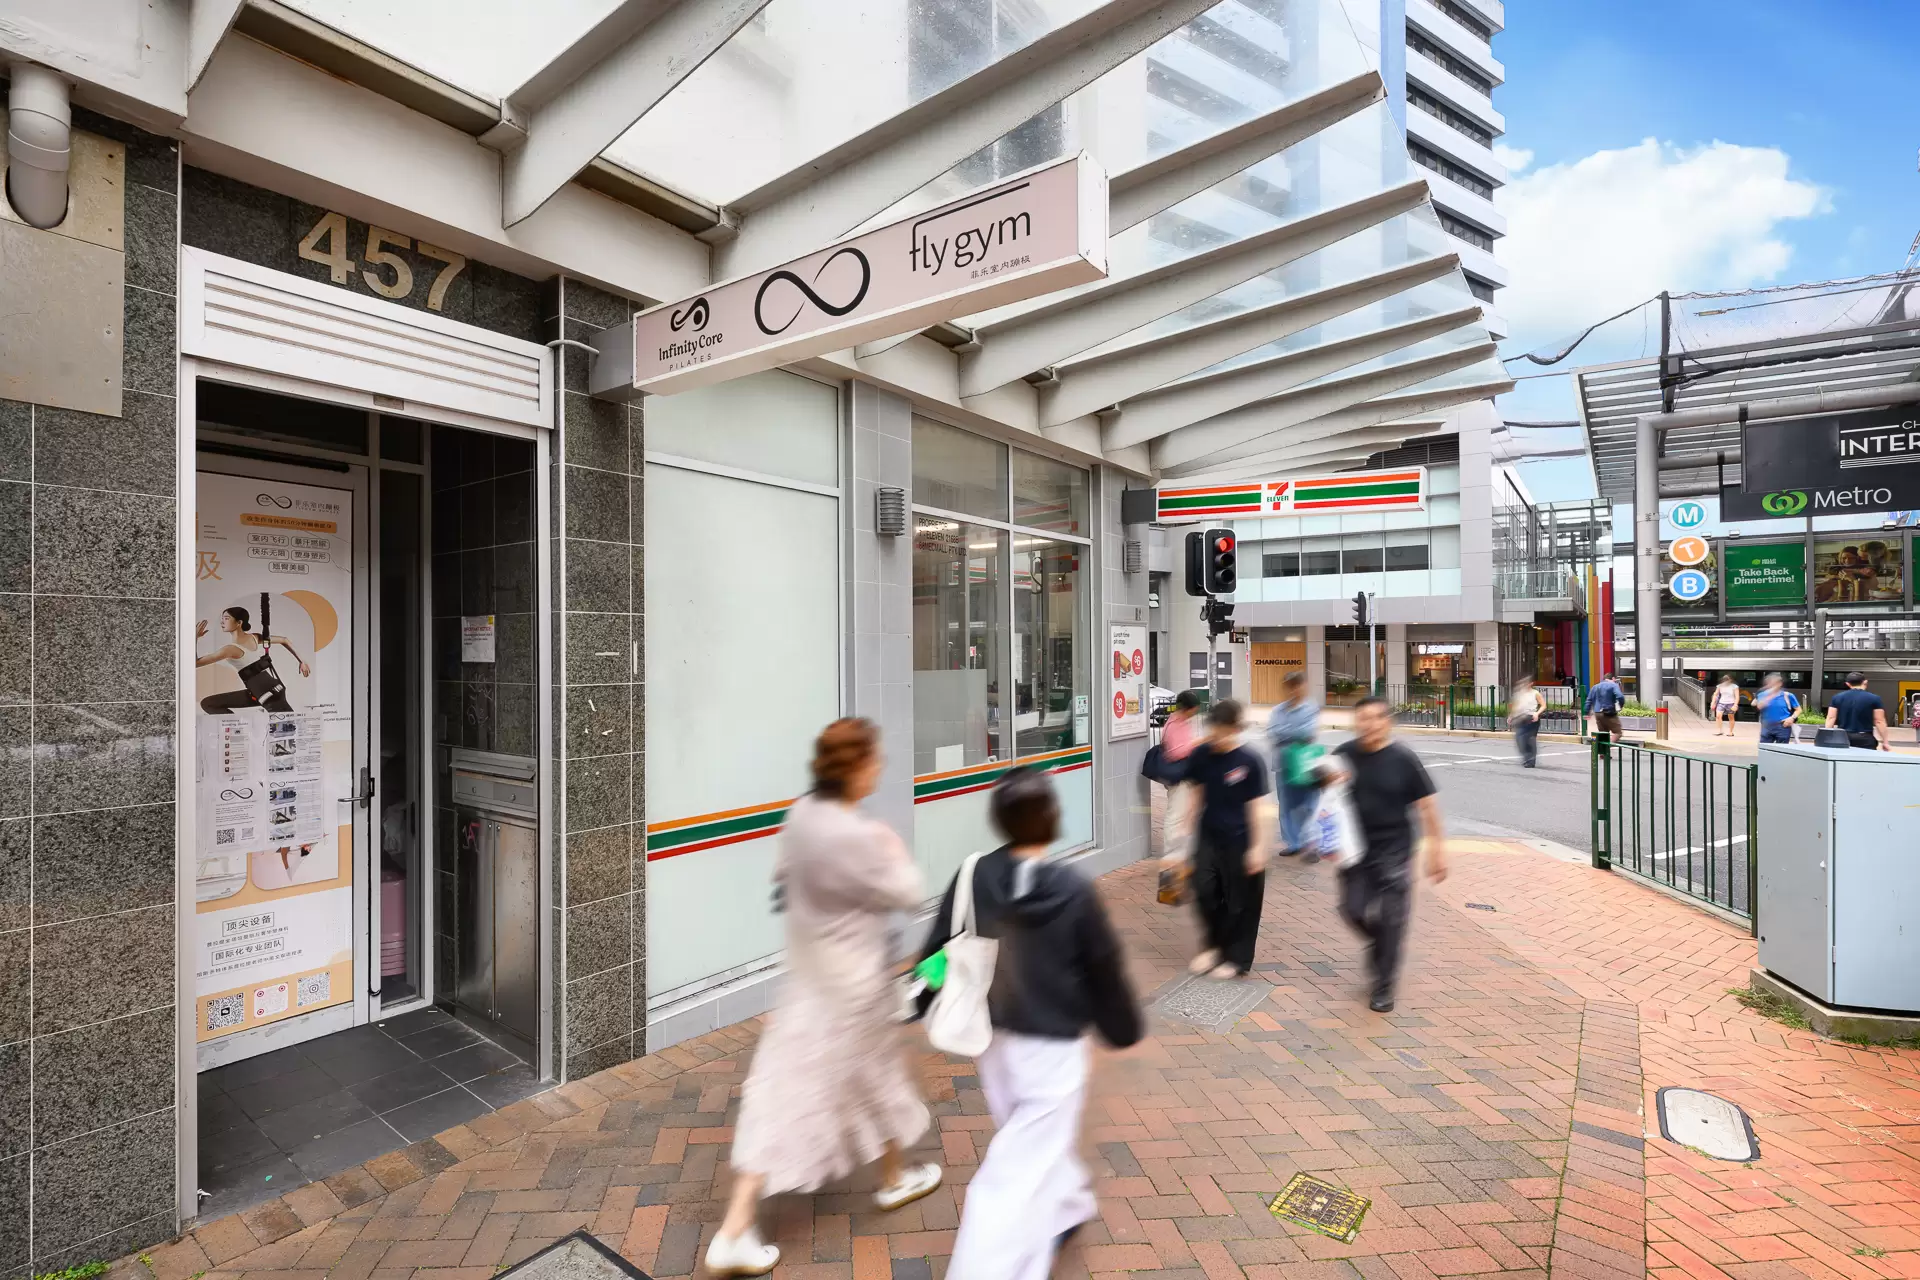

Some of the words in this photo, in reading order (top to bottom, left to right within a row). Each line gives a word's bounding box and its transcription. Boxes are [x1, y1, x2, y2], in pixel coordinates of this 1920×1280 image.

[299, 211, 466, 311] 457
[669, 353, 712, 372] PILATES
[1840, 432, 1920, 456] INTER
[1814, 486, 1892, 508] Metro
[1678, 507, 1698, 524] M
[252, 534, 284, 544] 室内飞行
[1678, 541, 1696, 559] T
[1734, 575, 1794, 584] Dinnertime!
[1739, 568, 1762, 577] Take
[1764, 568, 1790, 576] Back
[1682, 578, 1698, 594] B
[1134, 655, 1141, 666] $6
[1116, 698, 1122, 707] $8
[226, 915, 271, 932] 顶尖设备
[215, 940, 282, 960] 国际化专业团队
